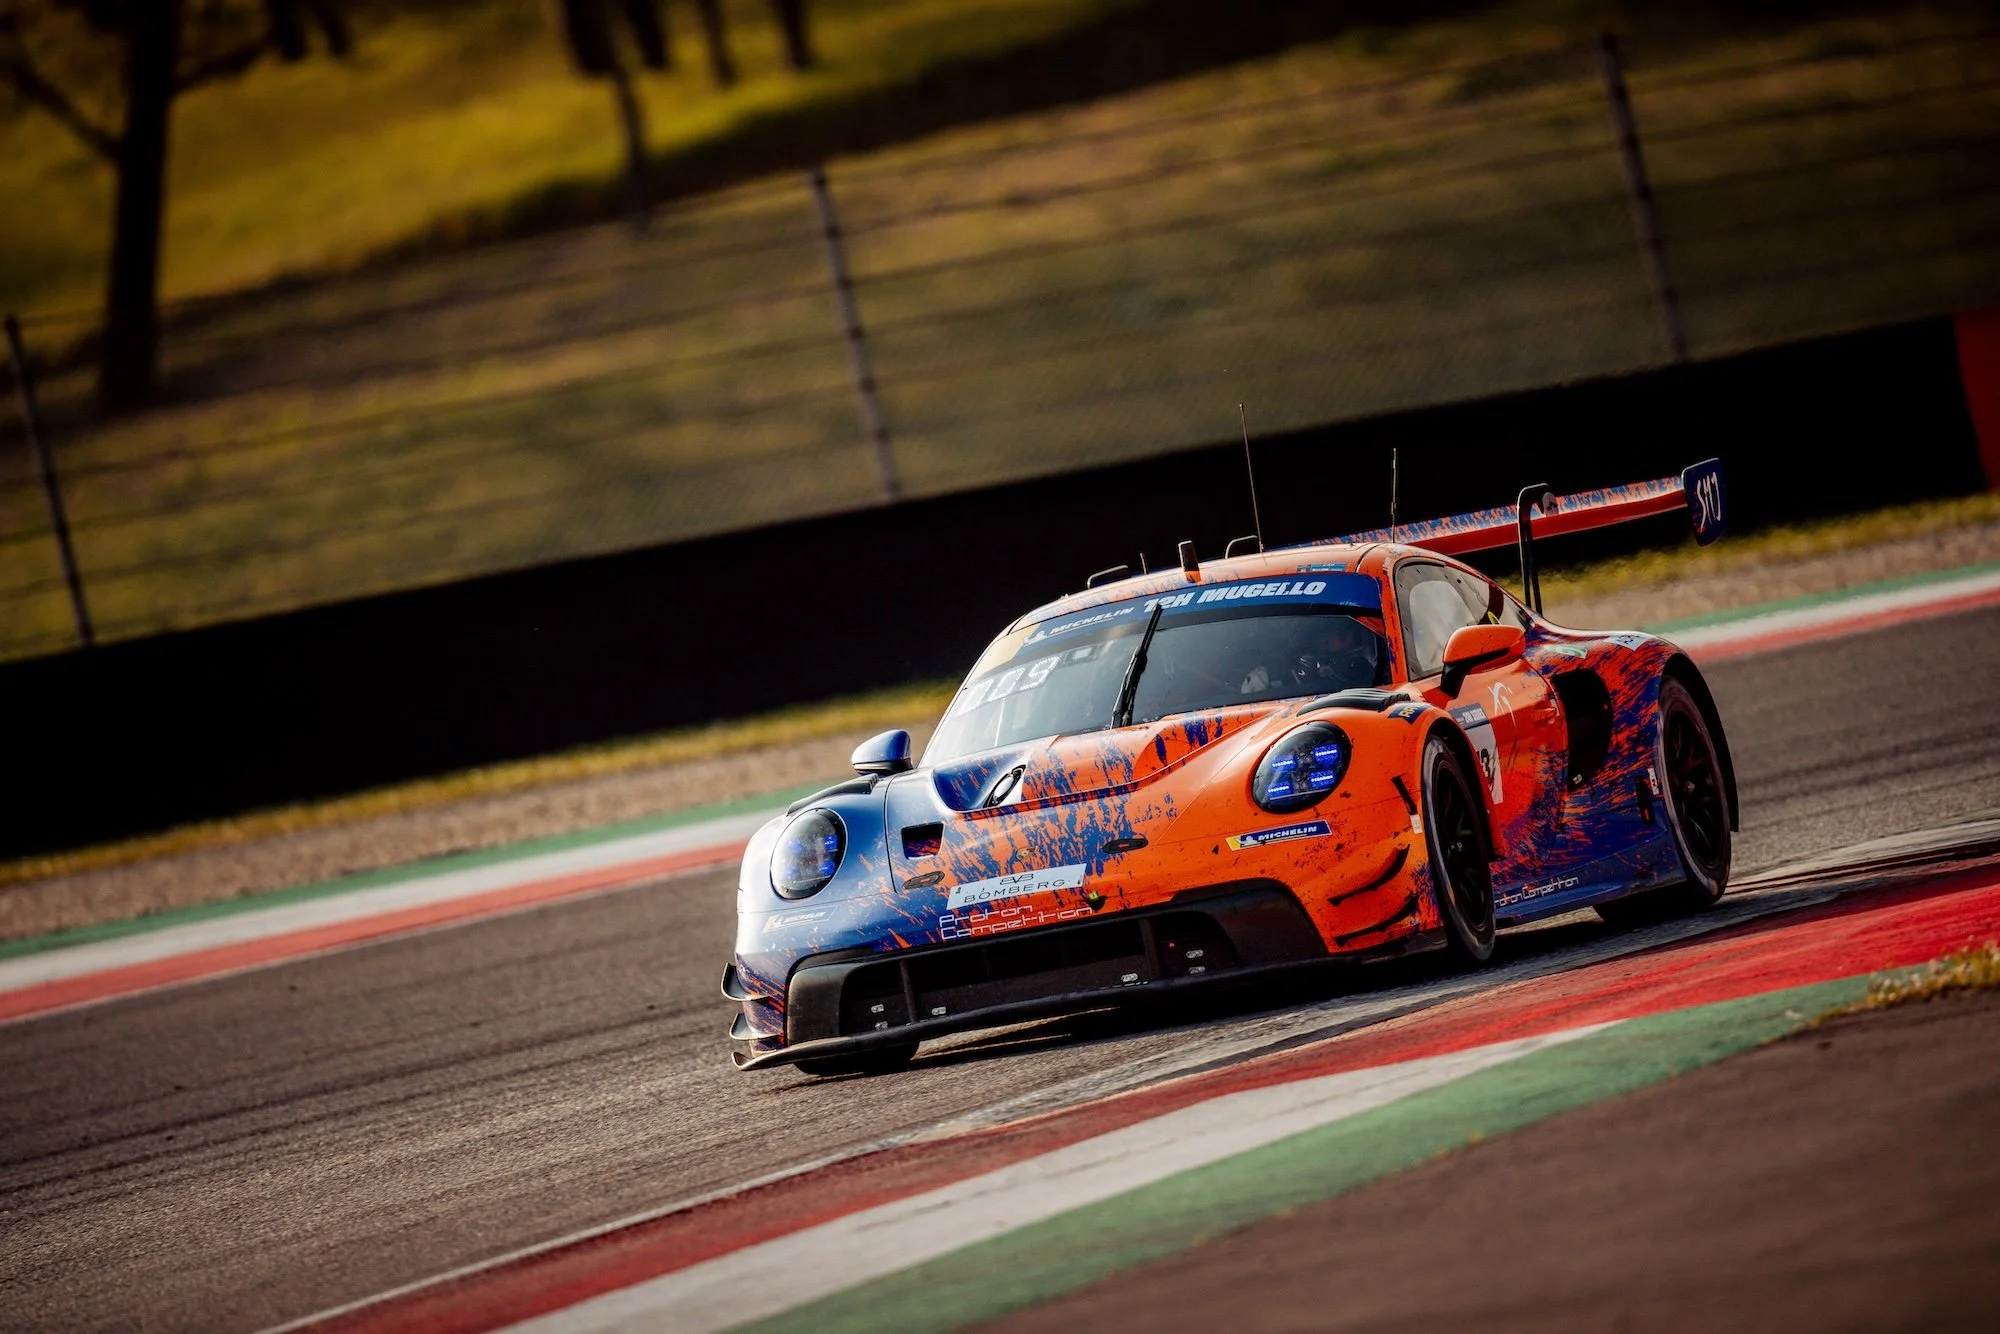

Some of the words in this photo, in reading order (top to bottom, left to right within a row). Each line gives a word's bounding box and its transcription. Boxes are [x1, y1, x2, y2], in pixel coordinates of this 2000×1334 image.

[1196, 581, 1326, 604] MUGELLO
[1050, 606, 1135, 635] MICHELIN
[1258, 826, 1318, 841] MICHELIN
[963, 879, 1066, 904] BOMBERG
[1494, 892, 1523, 907] roton
[938, 905, 1033, 928] Proton
[940, 907, 1093, 940] Competition
